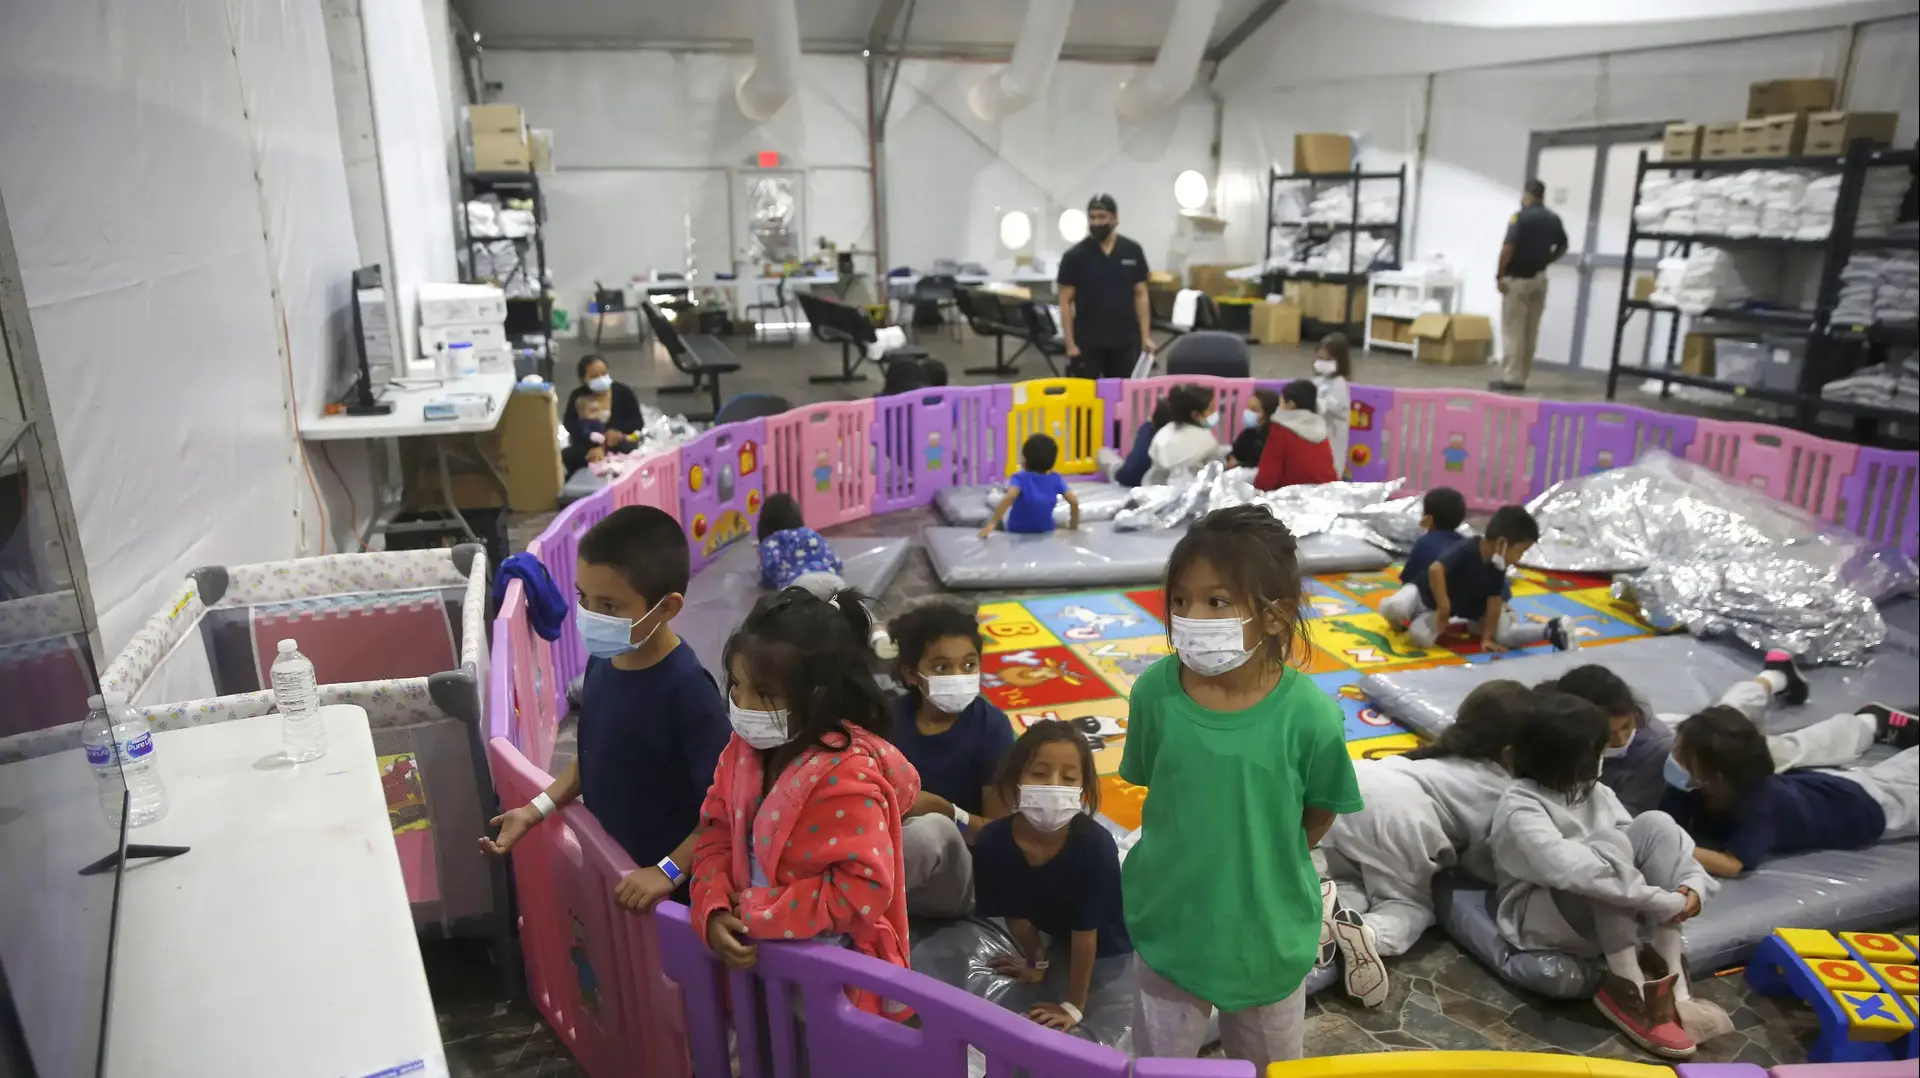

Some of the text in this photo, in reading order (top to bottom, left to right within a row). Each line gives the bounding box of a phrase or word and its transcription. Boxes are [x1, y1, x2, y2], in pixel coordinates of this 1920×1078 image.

[985, 620, 1039, 638] B
[1001, 649, 1042, 667] Y
[128, 740, 146, 752] Pure
[1854, 934, 1899, 951] O
[1818, 961, 1865, 982] O
[1884, 965, 1919, 984] O
[1841, 993, 1901, 1024] X
